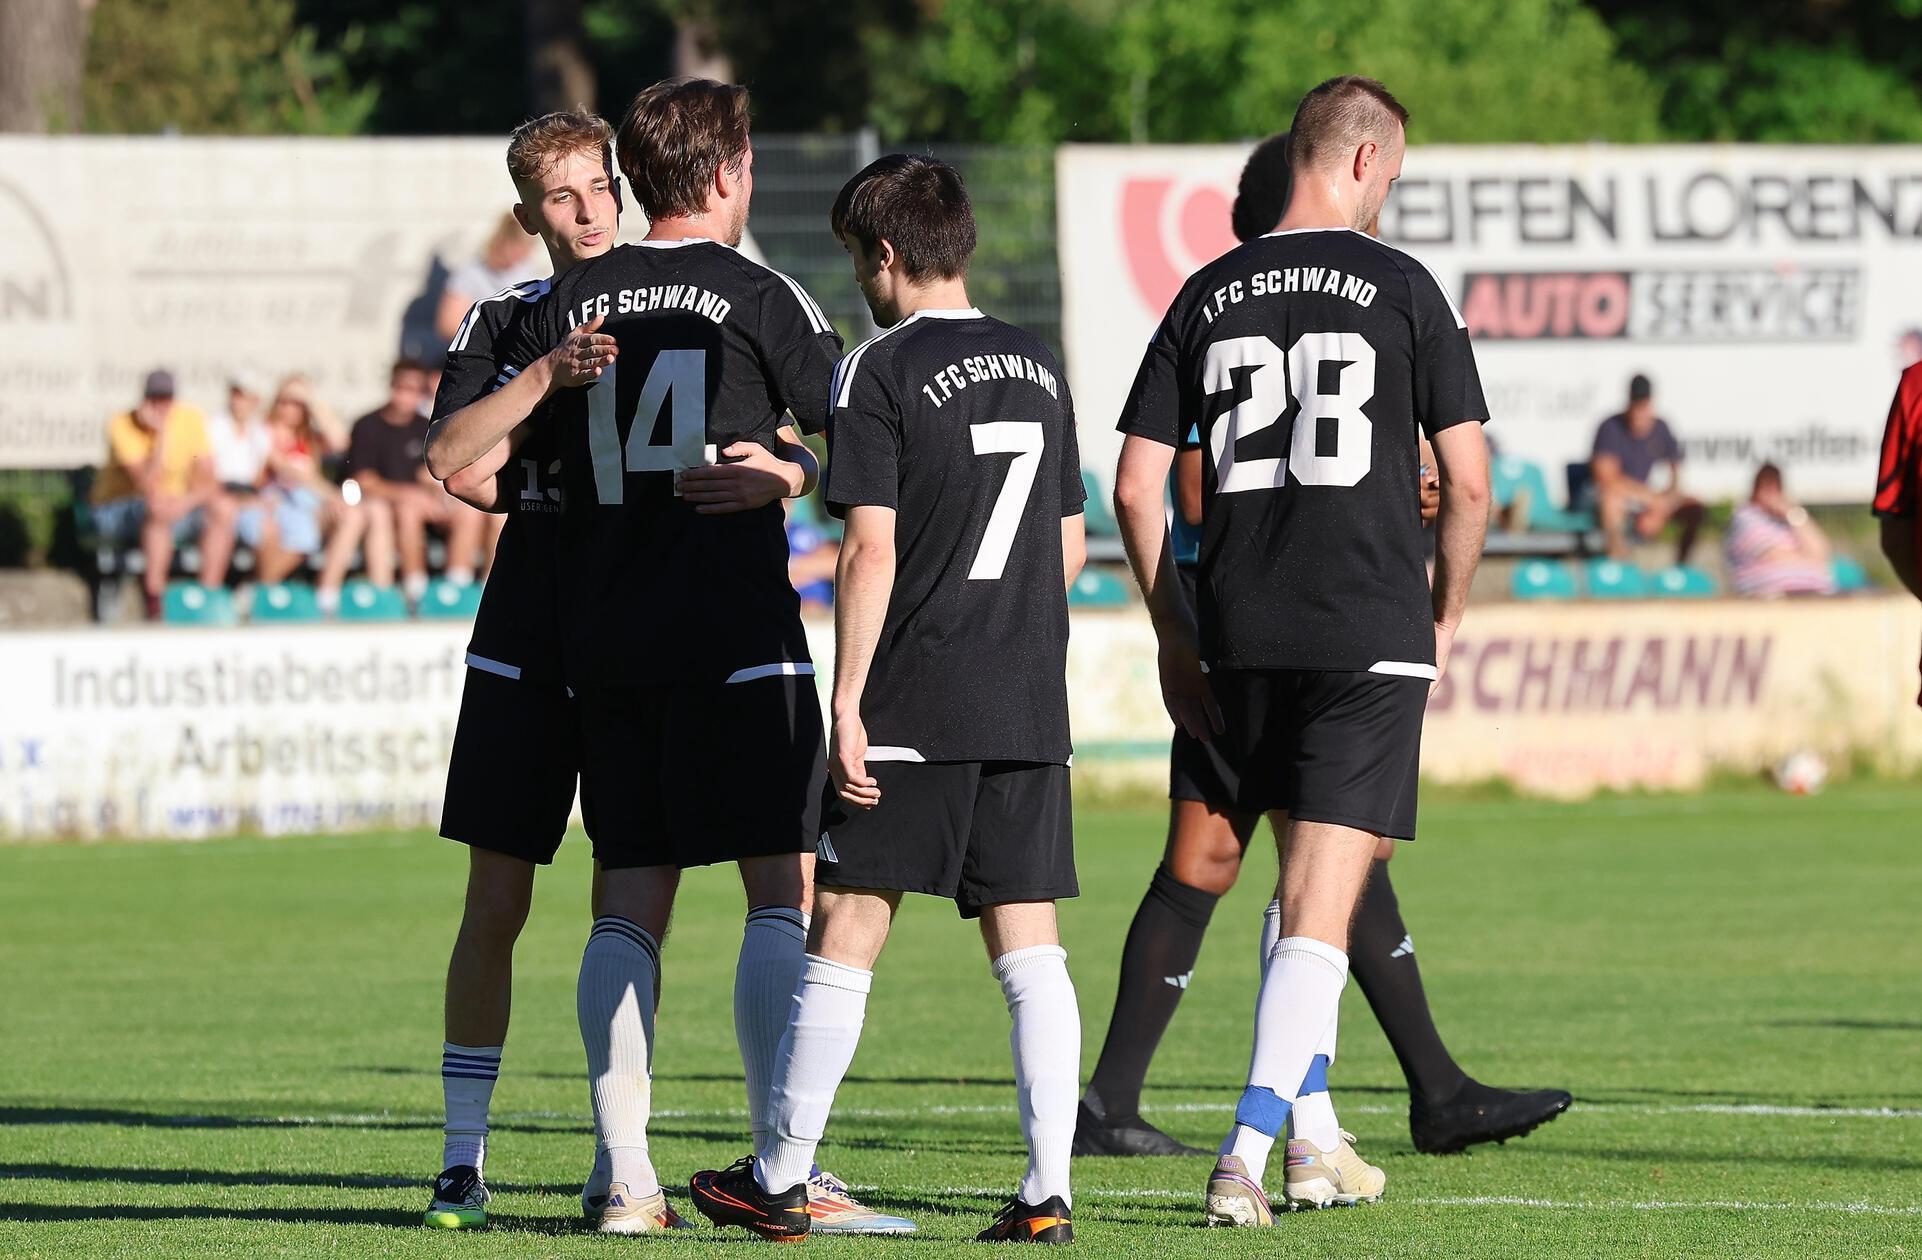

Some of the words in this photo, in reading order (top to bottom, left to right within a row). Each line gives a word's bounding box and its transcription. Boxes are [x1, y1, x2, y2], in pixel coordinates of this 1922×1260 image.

[617, 284, 732, 325] SCHWAND
[1251, 266, 1378, 308] SCHWAND
[1465, 272, 1631, 338] AUTO
[1646, 270, 1859, 338] SERVICE
[922, 364, 967, 409] 1.FC
[963, 354, 1058, 401] SCHWAND
[587, 349, 718, 505] 14
[1203, 332, 1377, 494] 28
[520, 501, 542, 512] USER
[967, 420, 1045, 581] 7
